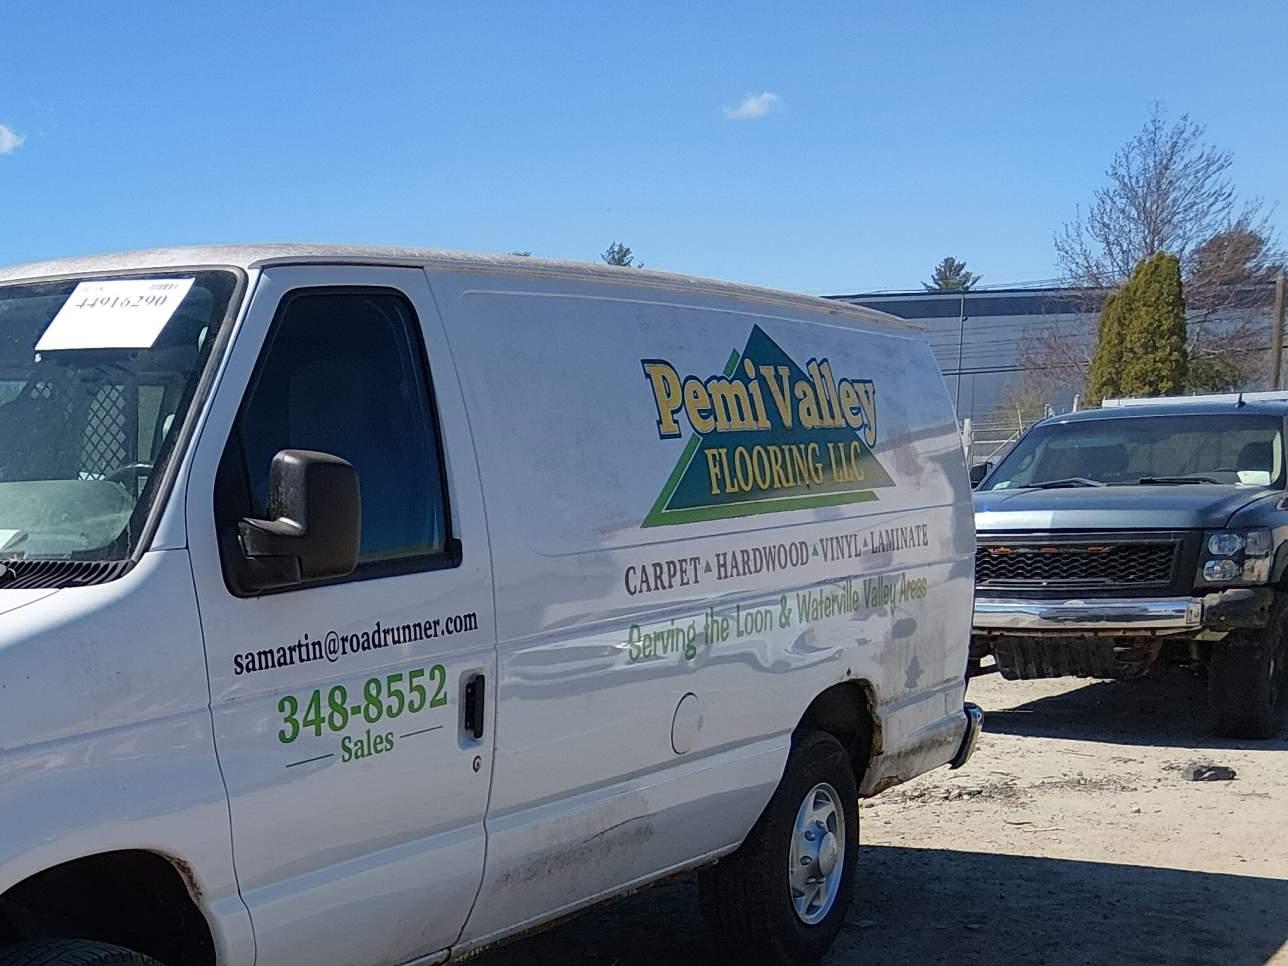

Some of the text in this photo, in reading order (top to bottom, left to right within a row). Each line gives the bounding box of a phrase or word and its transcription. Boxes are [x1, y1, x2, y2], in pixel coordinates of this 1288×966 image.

[76, 295, 168, 308] 44916290
[704, 439, 864, 496] FLOORING LLC
[624, 523, 929, 597] CARPET HARDWOOD VINYL LAMINATE
[233, 611, 479, 676] samartin@roadrunner.com
[628, 571, 928, 662] Serving the Loon & Waterville Valley Areas
[278, 664, 448, 744] 348-8552
[341, 729, 394, 763] Sales
